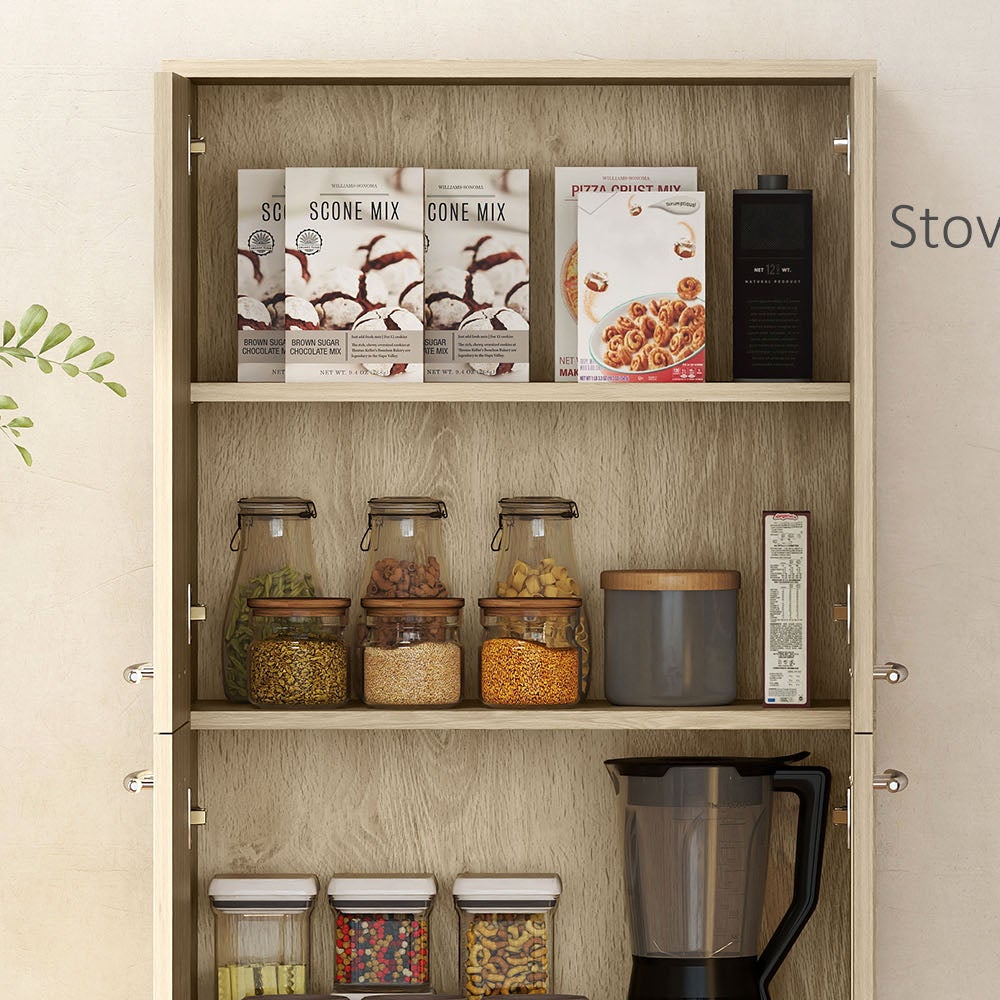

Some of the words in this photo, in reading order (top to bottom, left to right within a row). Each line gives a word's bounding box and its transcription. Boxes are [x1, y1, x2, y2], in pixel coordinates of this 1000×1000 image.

[309, 201, 363, 221] SCONE
[371, 201, 400, 221] MIX
[427, 202, 470, 222] CONE
[477, 202, 506, 222] MIX
[243, 338, 269, 346] BROWN
[269, 338, 286, 346] SUGA
[291, 338, 316, 347] BROWN
[317, 338, 340, 347] SUGAR
[424, 338, 447, 346] SUGAR
[242, 347, 280, 355] CHOCOLATE
[289, 347, 328, 356] CHOCOLATE
[329, 347, 342, 356] MIX
[435, 347, 449, 355] MIX
[559, 356, 574, 365] NET
[559, 368, 578, 377] MAK
